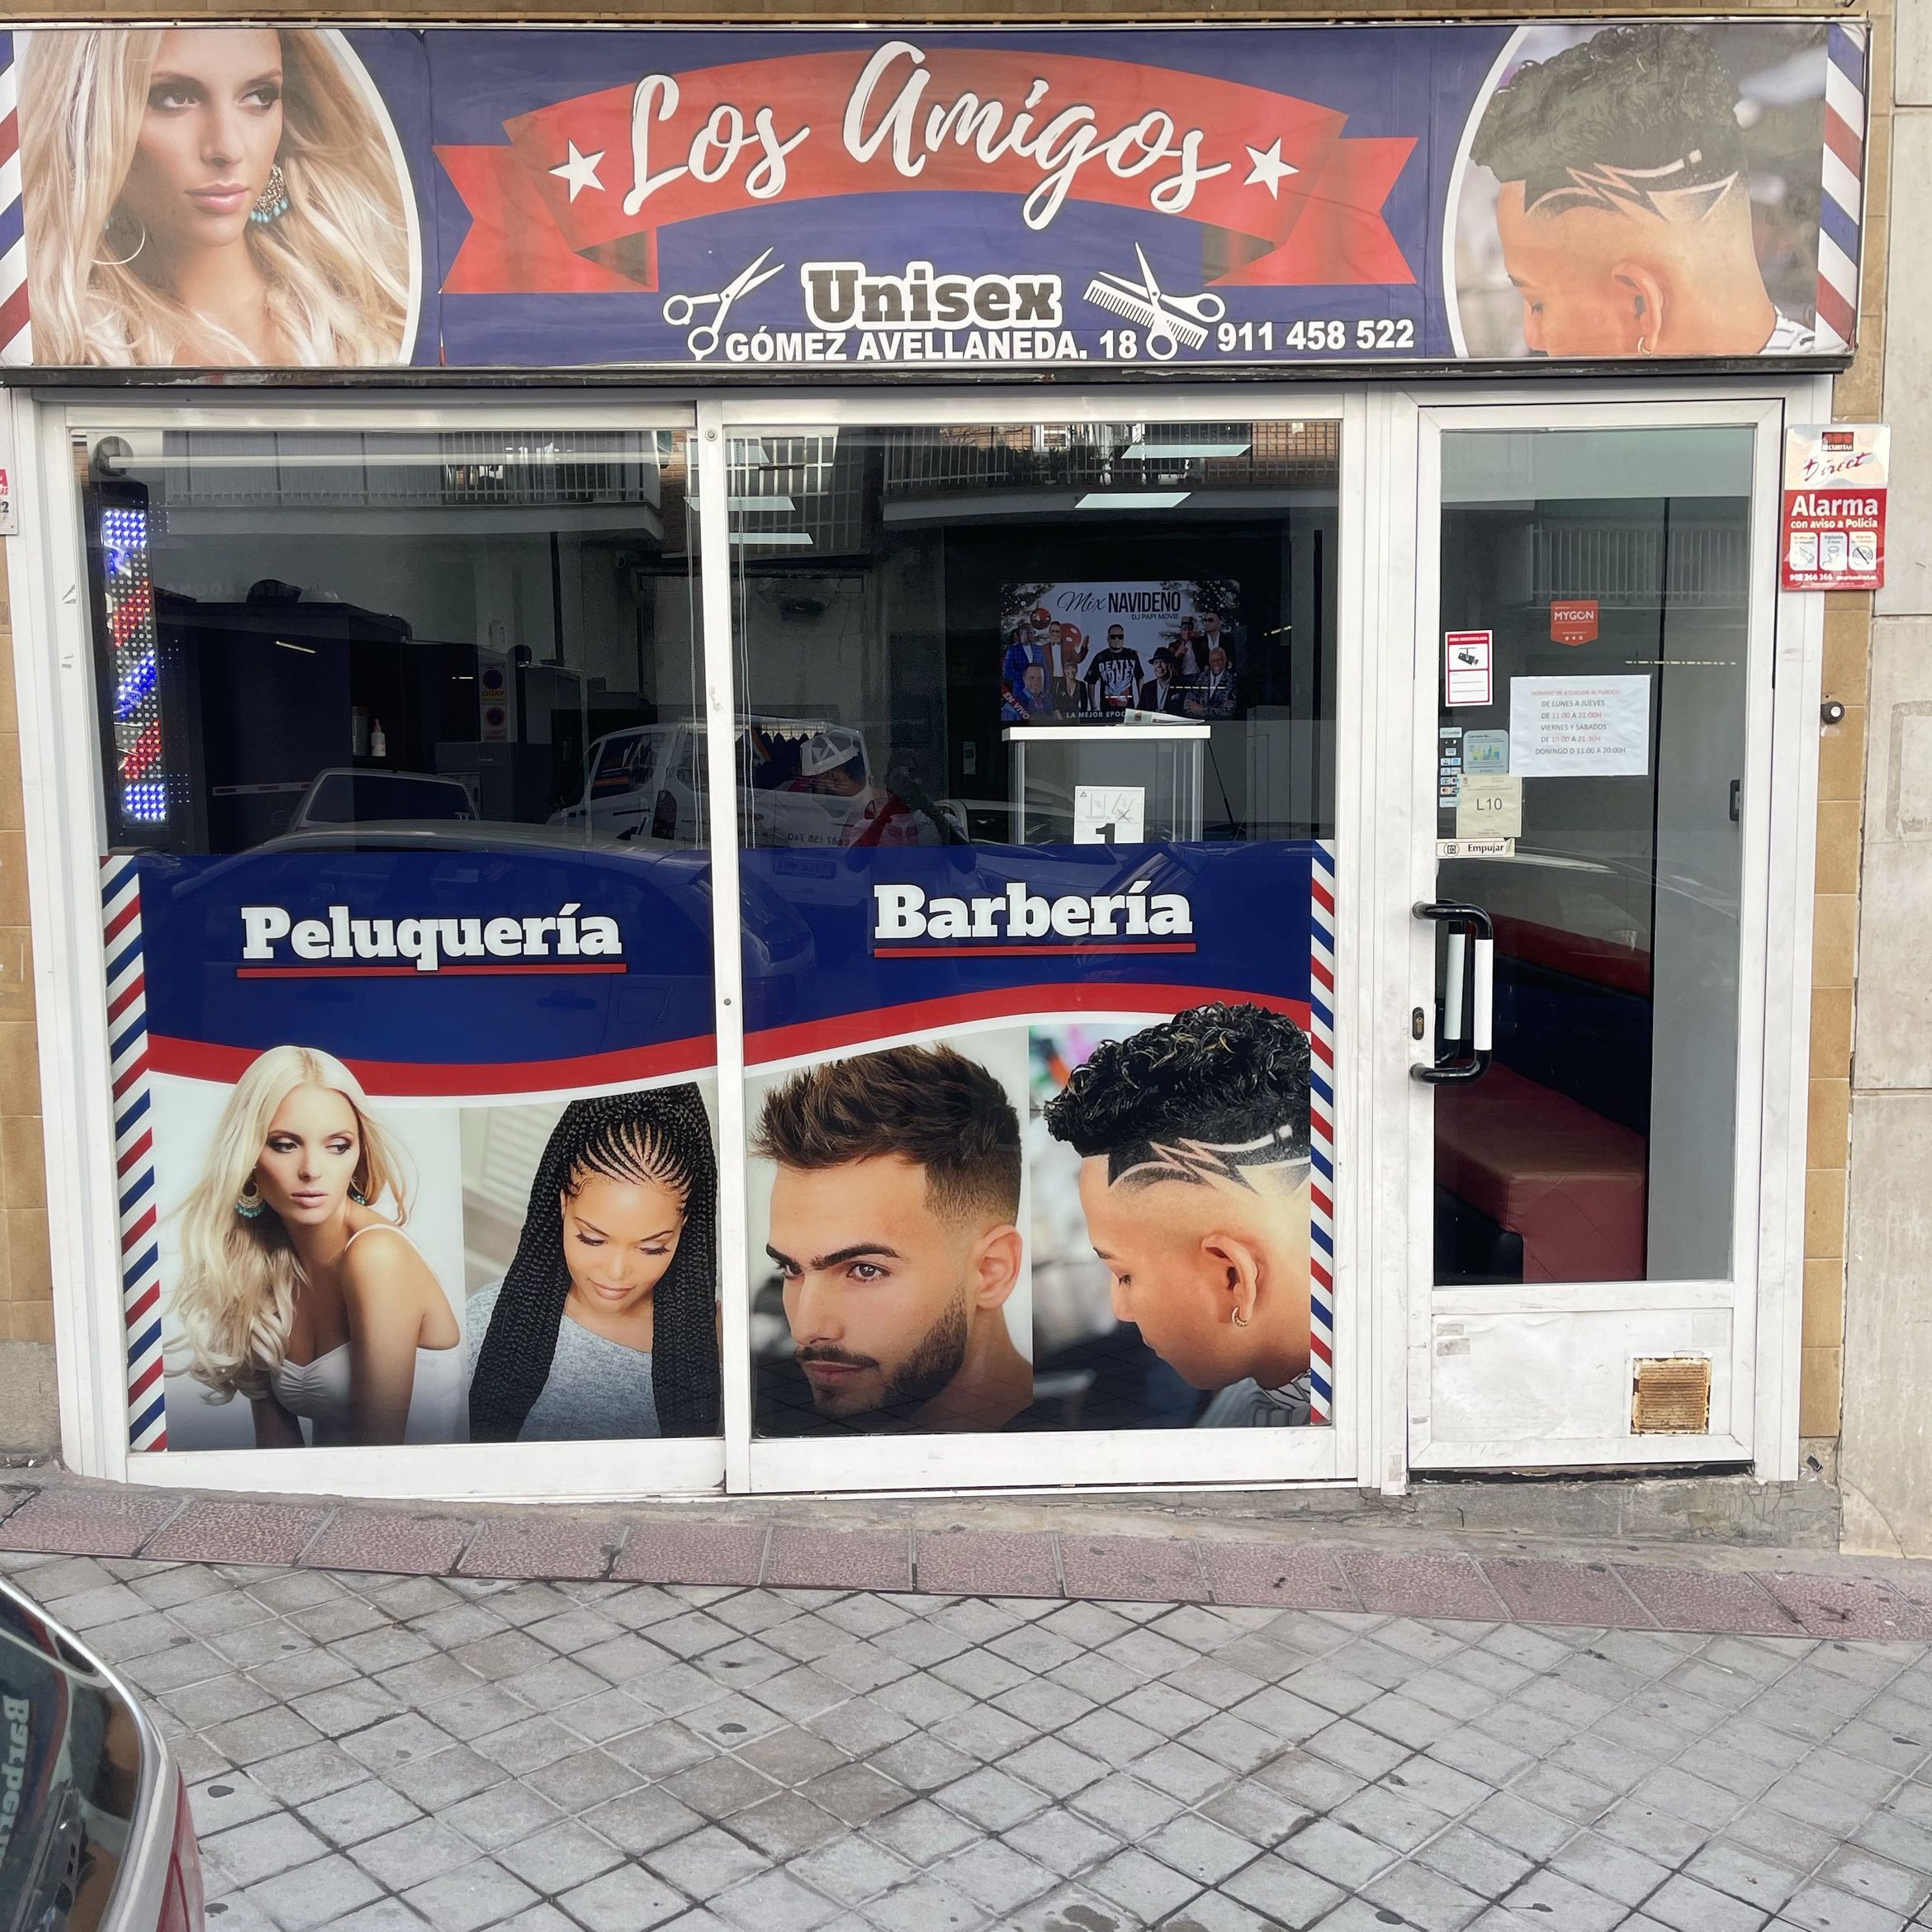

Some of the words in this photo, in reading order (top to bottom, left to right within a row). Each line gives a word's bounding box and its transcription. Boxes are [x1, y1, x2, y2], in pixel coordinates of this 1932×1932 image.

[623, 73, 810, 215] Los
[843, 40, 1232, 230] Amigos
[804, 264, 1058, 327] Unisex
[725, 325, 846, 362] GÓMEZ
[1099, 330, 1138, 359] 18
[1217, 321, 1273, 352] 911
[1286, 320, 1346, 350] 458
[1356, 319, 1414, 348] 522
[1791, 494, 1878, 517] Alarma
[1790, 520, 1808, 528] con
[1810, 518, 1835, 528] aviso
[1837, 520, 1844, 528] a
[1057, 591, 1106, 613] Mix
[1108, 587, 1181, 613] NAVIDEÑO
[1014, 702, 1030, 720] VIVO
[1476, 798, 1503, 811] L10
[1467, 843, 1504, 854] Empujar
[874, 880, 1193, 939] Barbería
[240, 902, 623, 971] Peluquería
